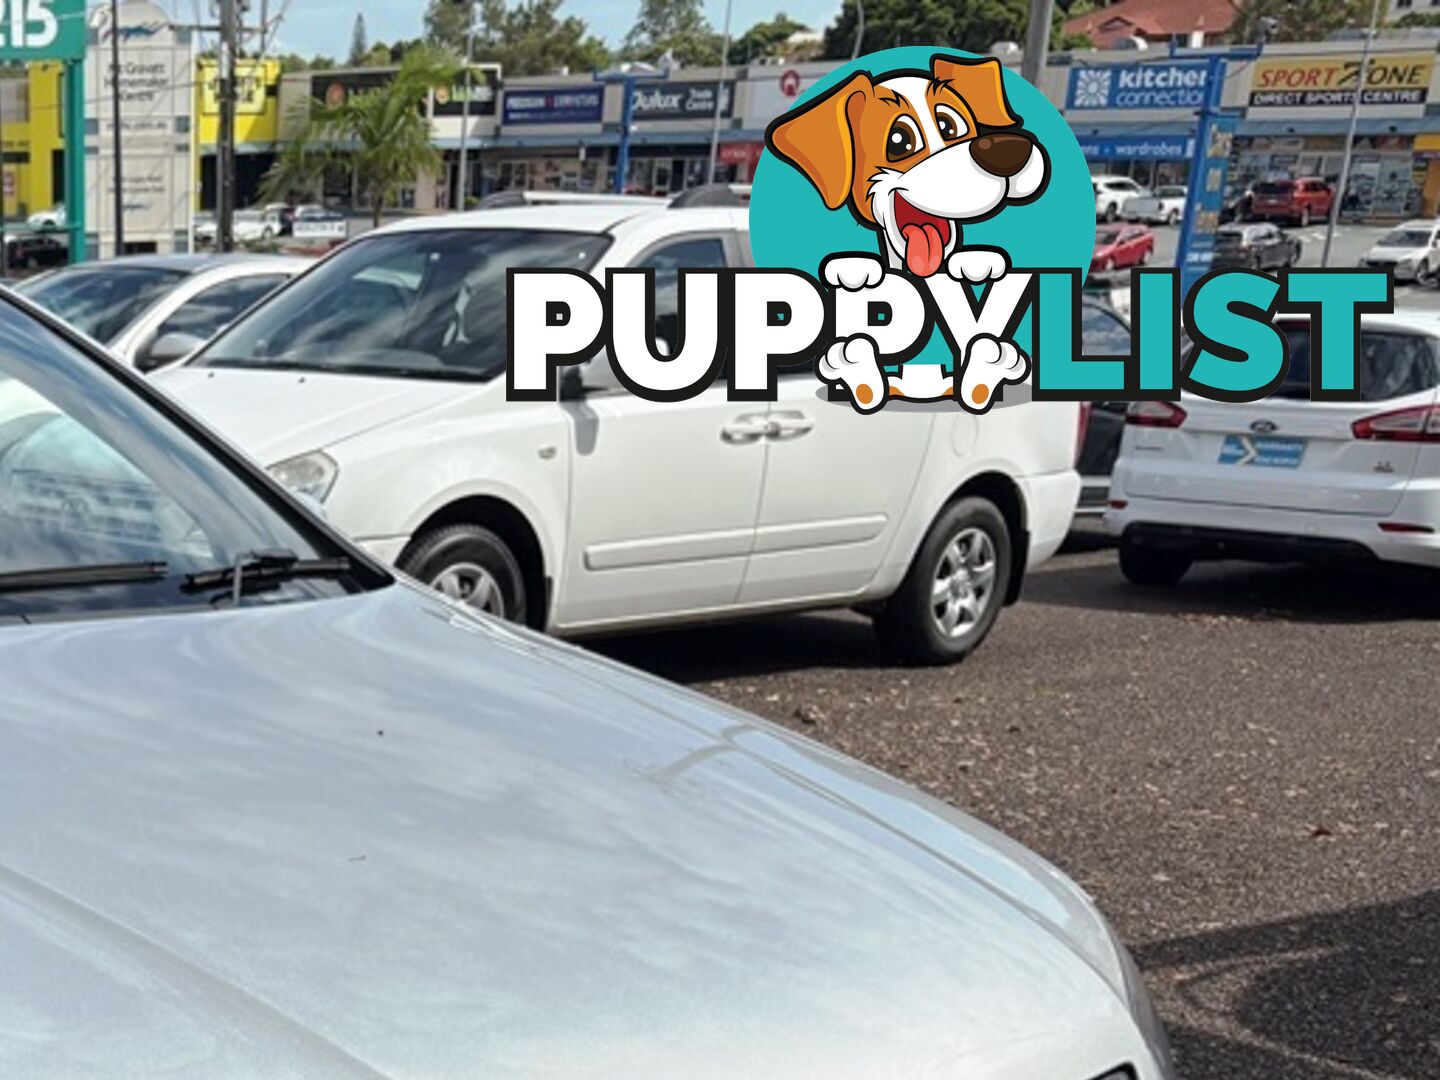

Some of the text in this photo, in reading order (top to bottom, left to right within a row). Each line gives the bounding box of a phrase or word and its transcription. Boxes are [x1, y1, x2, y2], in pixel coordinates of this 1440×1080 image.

[1116, 88, 1205, 106] connectio
[1363, 91, 1420, 103] CENTRE
[1116, 141, 1182, 156] wardrobes
